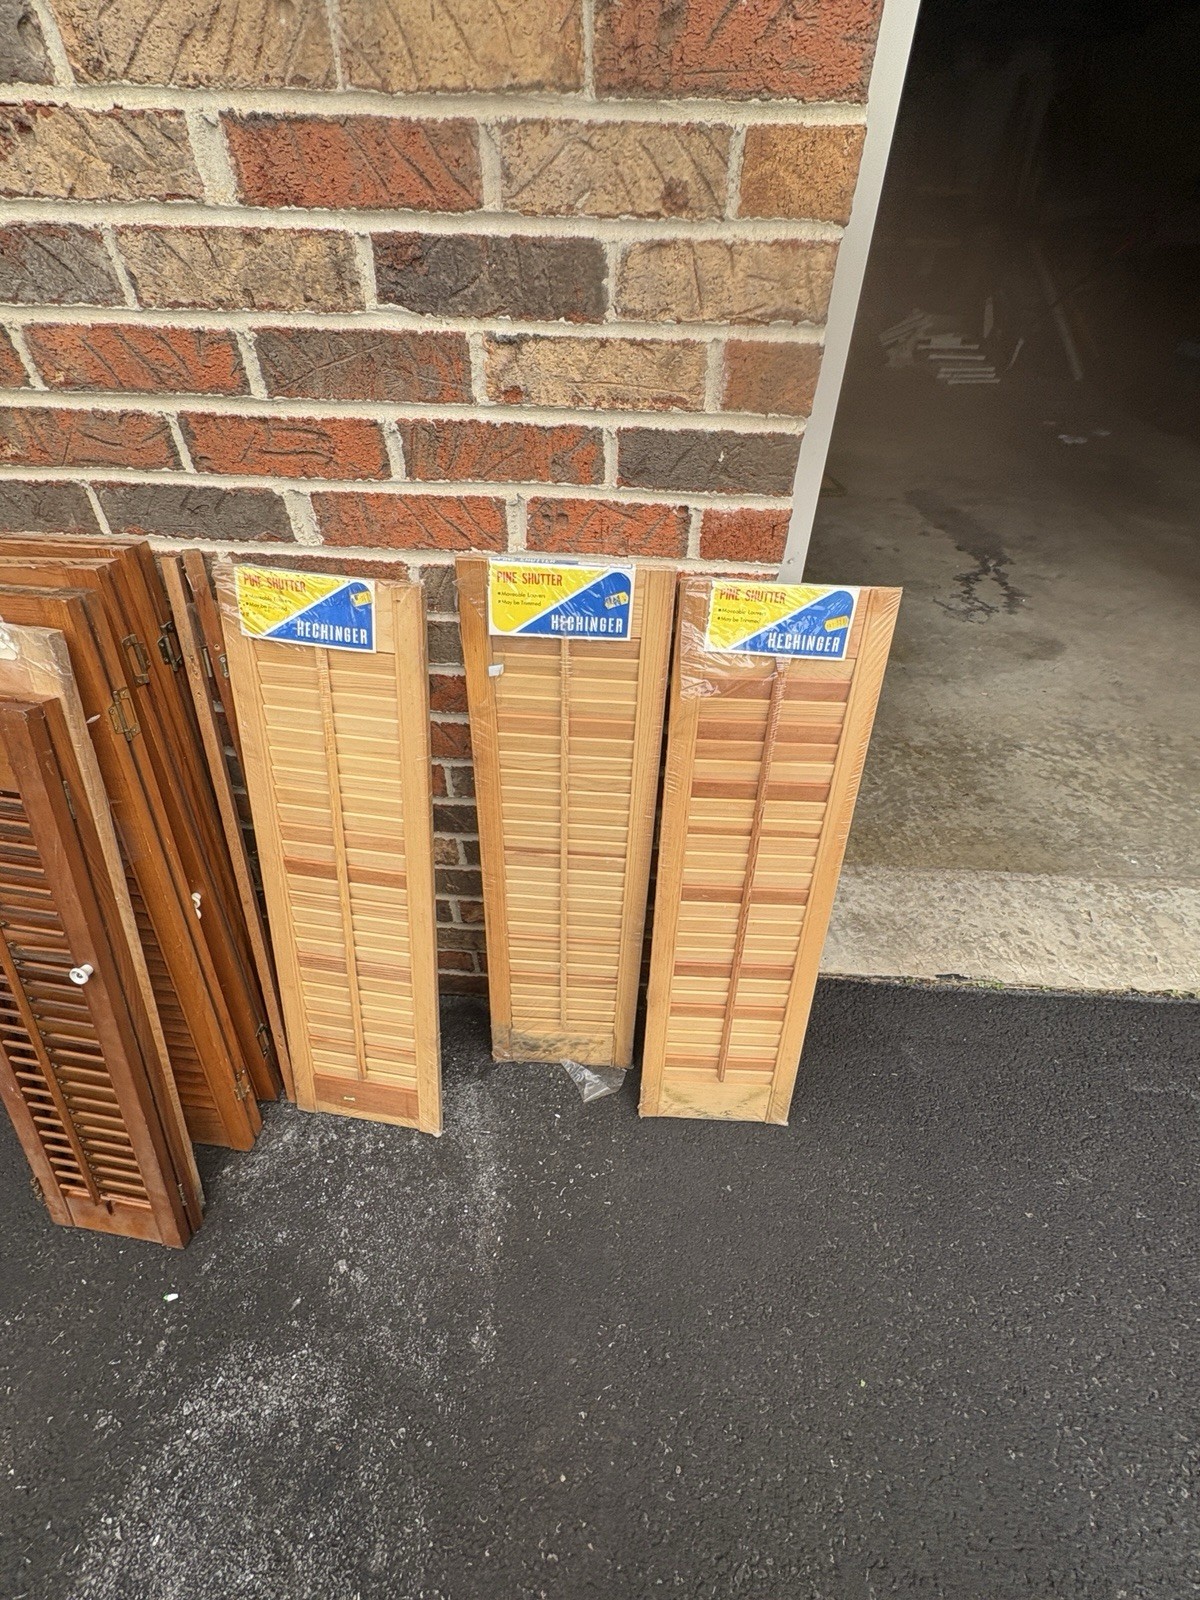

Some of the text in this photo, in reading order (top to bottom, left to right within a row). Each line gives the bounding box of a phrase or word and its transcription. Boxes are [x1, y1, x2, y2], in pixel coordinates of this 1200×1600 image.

[266, 577, 307, 592] SHUTTER
[496, 571, 563, 587] PINE SHUTTER
[719, 588, 787, 605] PINE SHUTTER
[296, 620, 369, 645] HECHINGER
[550, 614, 624, 634] HECHINGER
[766, 631, 841, 653] HECHINGER
